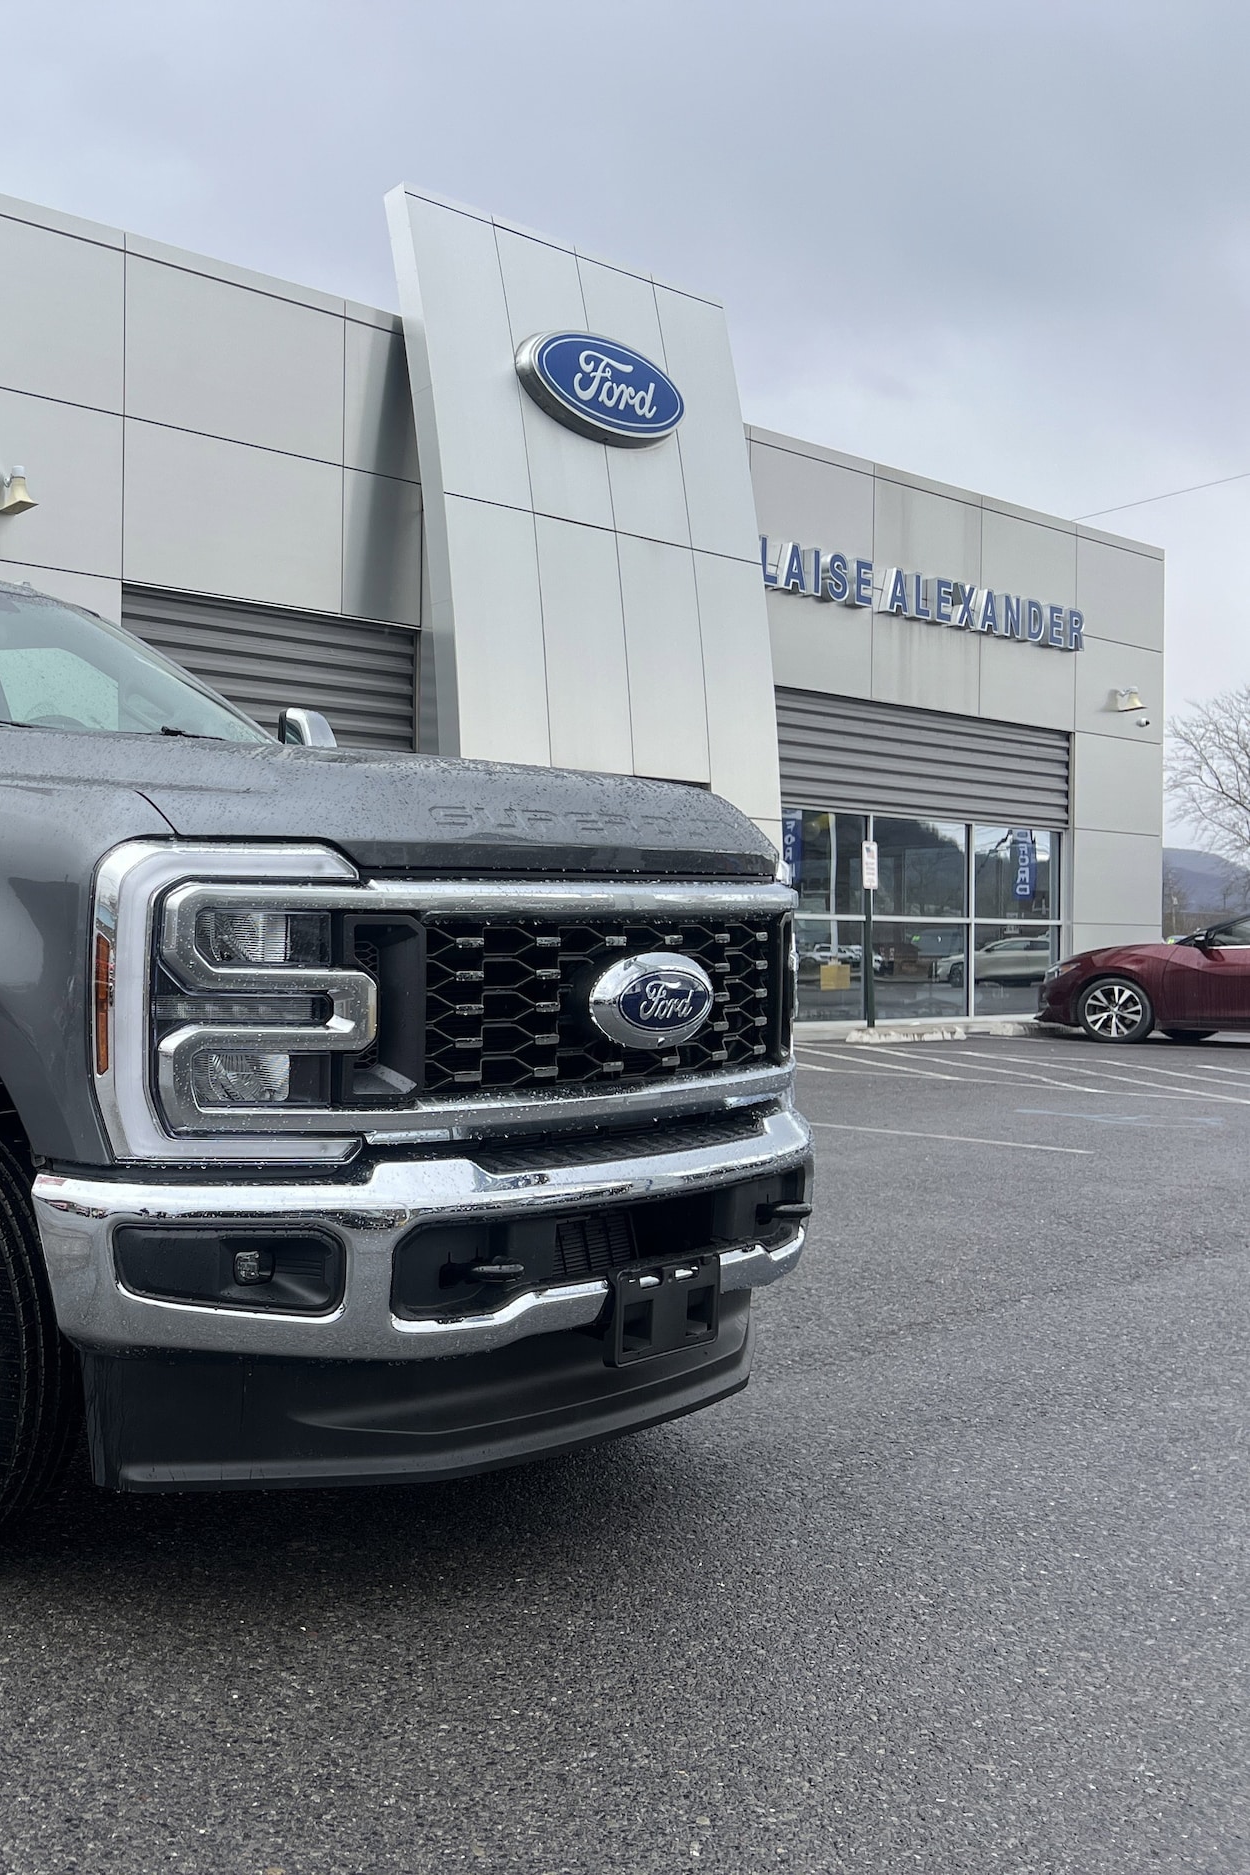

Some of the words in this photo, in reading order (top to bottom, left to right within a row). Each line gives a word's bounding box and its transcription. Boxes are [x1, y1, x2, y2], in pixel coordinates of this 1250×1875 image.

[573, 350, 658, 419] Ford
[758, 534, 875, 608] LAISE
[886, 566, 1086, 652] ALEXANDER
[639, 980, 695, 1021] Ford
